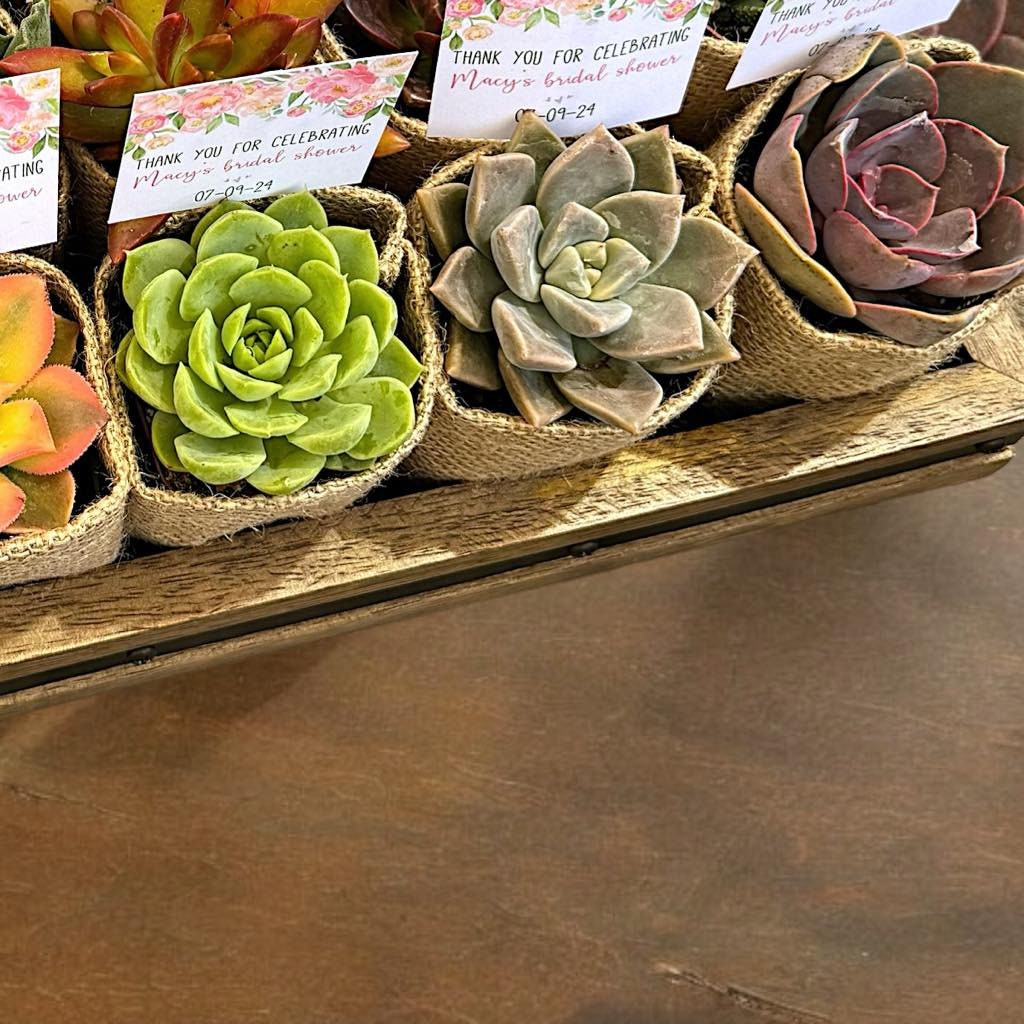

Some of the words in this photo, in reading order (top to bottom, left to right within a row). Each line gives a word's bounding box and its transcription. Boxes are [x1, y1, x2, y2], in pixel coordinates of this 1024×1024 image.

[770, 1, 816, 25] THANK
[453, 49, 501, 65] THANK
[513, 50, 543, 66] YOU
[553, 48, 584, 65] FOR
[593, 26, 692, 61] CELEBRATING
[450, 68, 535, 93] Macy's
[543, 64, 608, 88] bridal
[615, 53, 682, 77] shower
[515, 102, 596, 123] 0-09-24
[133, 162, 214, 188] Macy's
[222, 149, 287, 173] bridal
[293, 143, 362, 161] shower
[136, 152, 184, 170] THANK
[193, 146, 223, 161] YOU
[231, 139, 262, 155] FOR
[271, 121, 372, 149] CELEBRATING
[194, 179, 274, 202] 07-09-24
